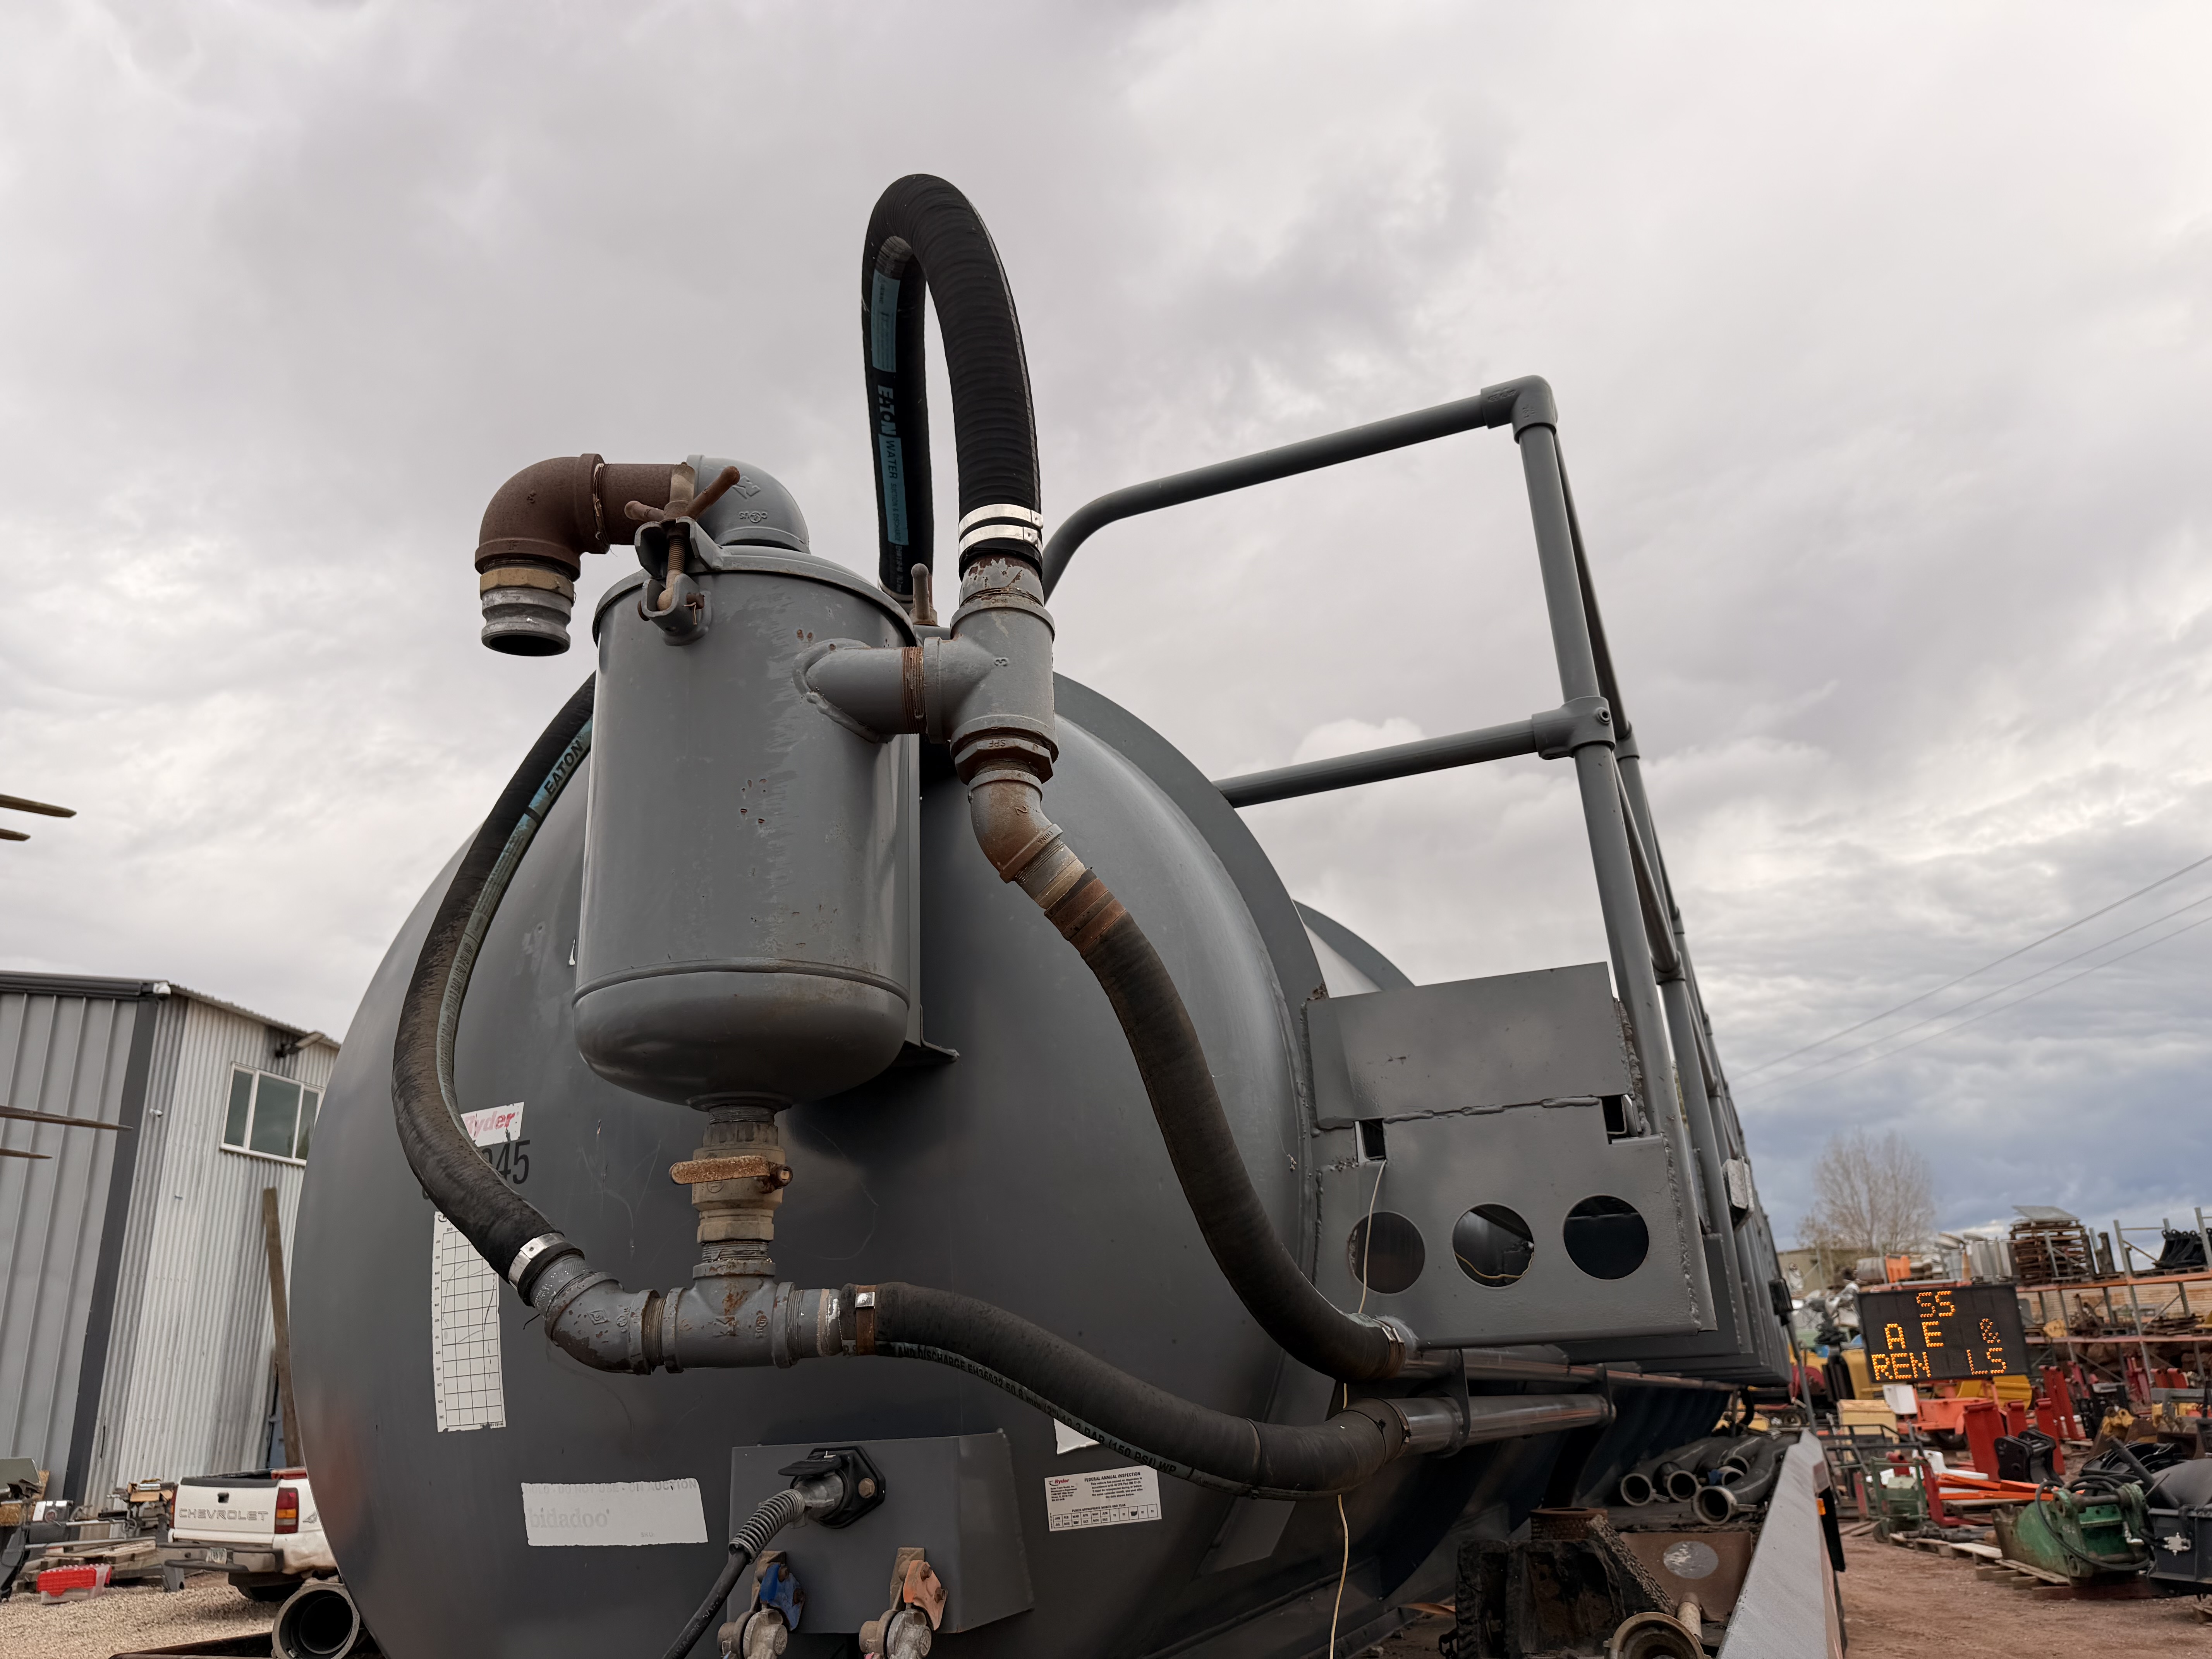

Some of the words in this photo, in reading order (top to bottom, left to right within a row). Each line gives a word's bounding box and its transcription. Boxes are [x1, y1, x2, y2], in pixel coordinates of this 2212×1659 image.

[878, 385, 896, 435] EATON
[886, 440, 898, 479] WATER
[544, 739, 584, 797] EATON
[464, 943, 474, 956] WP
[465, 1111, 515, 1138] Ryder
[1916, 1290, 1956, 1318] SS
[1884, 1323, 1906, 1350] A
[1922, 1321, 1944, 1348] E
[1980, 1317, 2001, 1344] &
[917, 1345, 965, 1370] DISCHARGE
[1084, 1427, 1105, 1444] BAR
[1108, 1439, 1131, 1458] (150
[1134, 1451, 1156, 1467] PSI)
[1159, 1460, 1177, 1474] WP
[558, 1485, 571, 1494] DO
[574, 1484, 595, 1493] NOT
[599, 1483, 620, 1493] USE
[630, 1482, 644, 1492] ON
[647, 1479, 697, 1491] AUCTION
[179, 1508, 269, 1522] CHEVROLET
[528, 1508, 608, 1528] bidadoo
